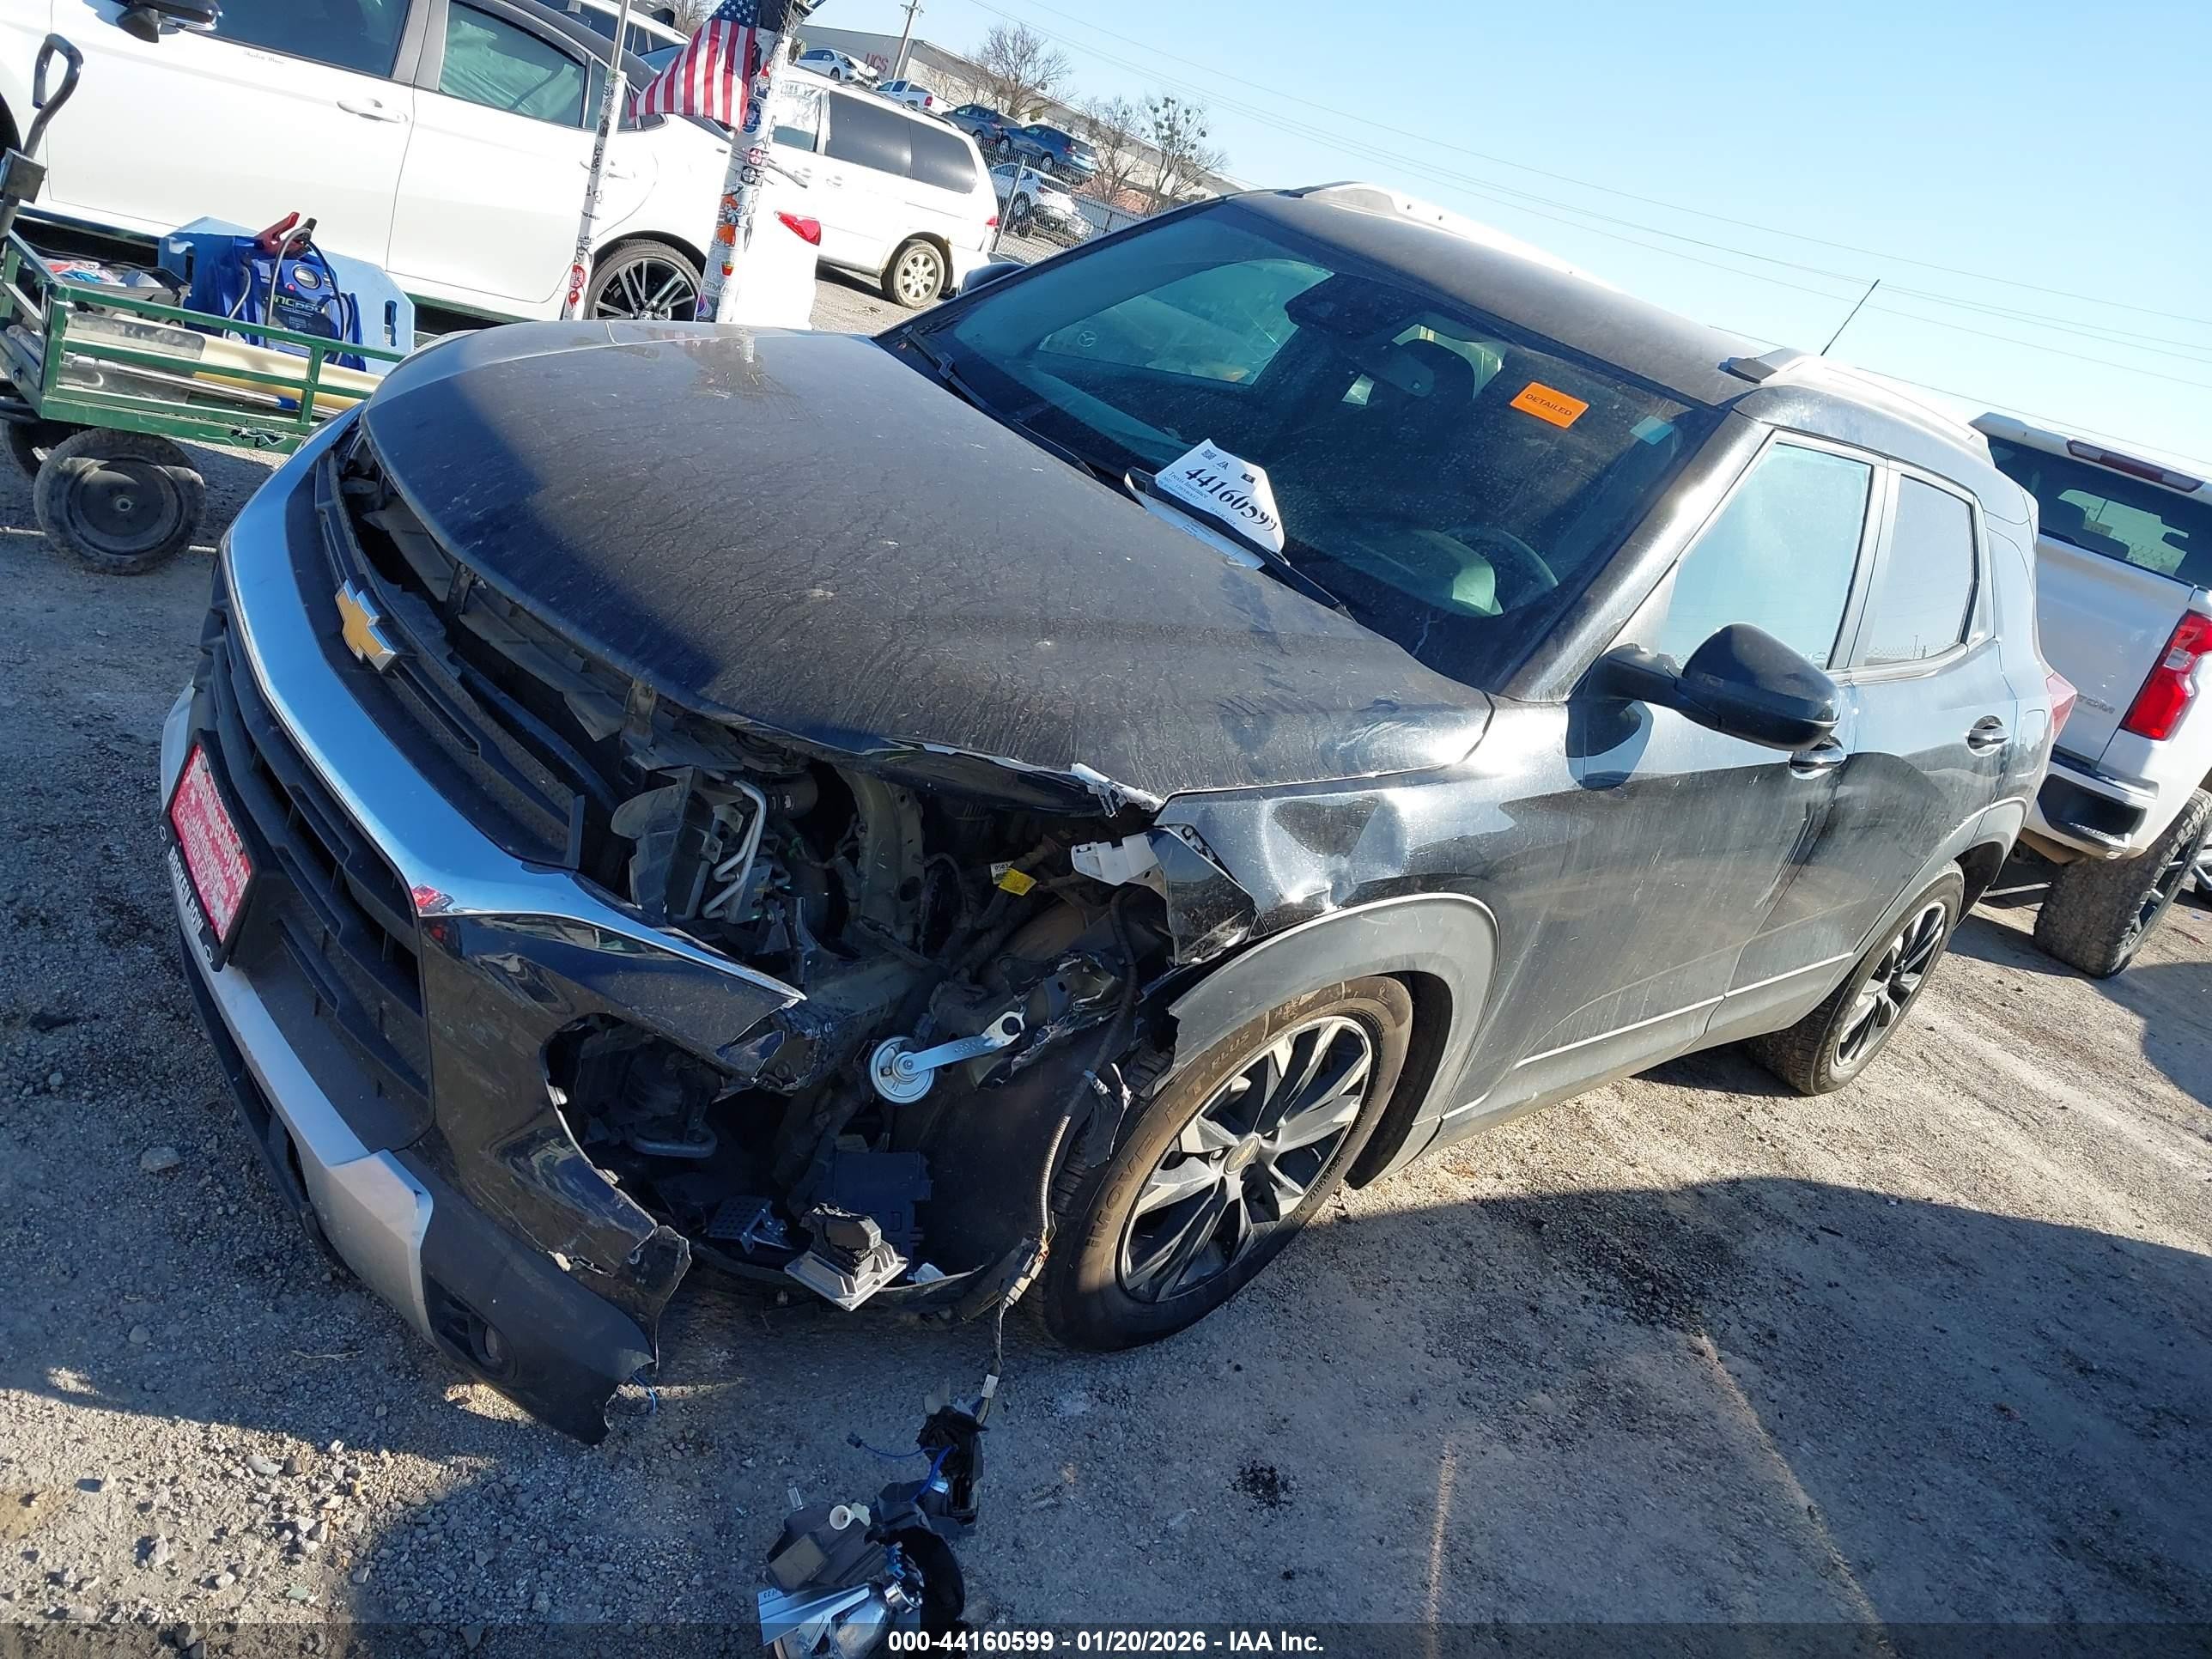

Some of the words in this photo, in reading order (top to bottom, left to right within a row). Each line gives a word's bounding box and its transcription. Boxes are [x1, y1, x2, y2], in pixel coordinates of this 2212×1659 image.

[866, 52, 889, 74] UCS
[1525, 393, 1573, 416] DETAILED
[175, 805, 209, 879] CHEVROLET
[168, 845, 191, 905] BROKEN
[187, 897, 204, 936] BOW
